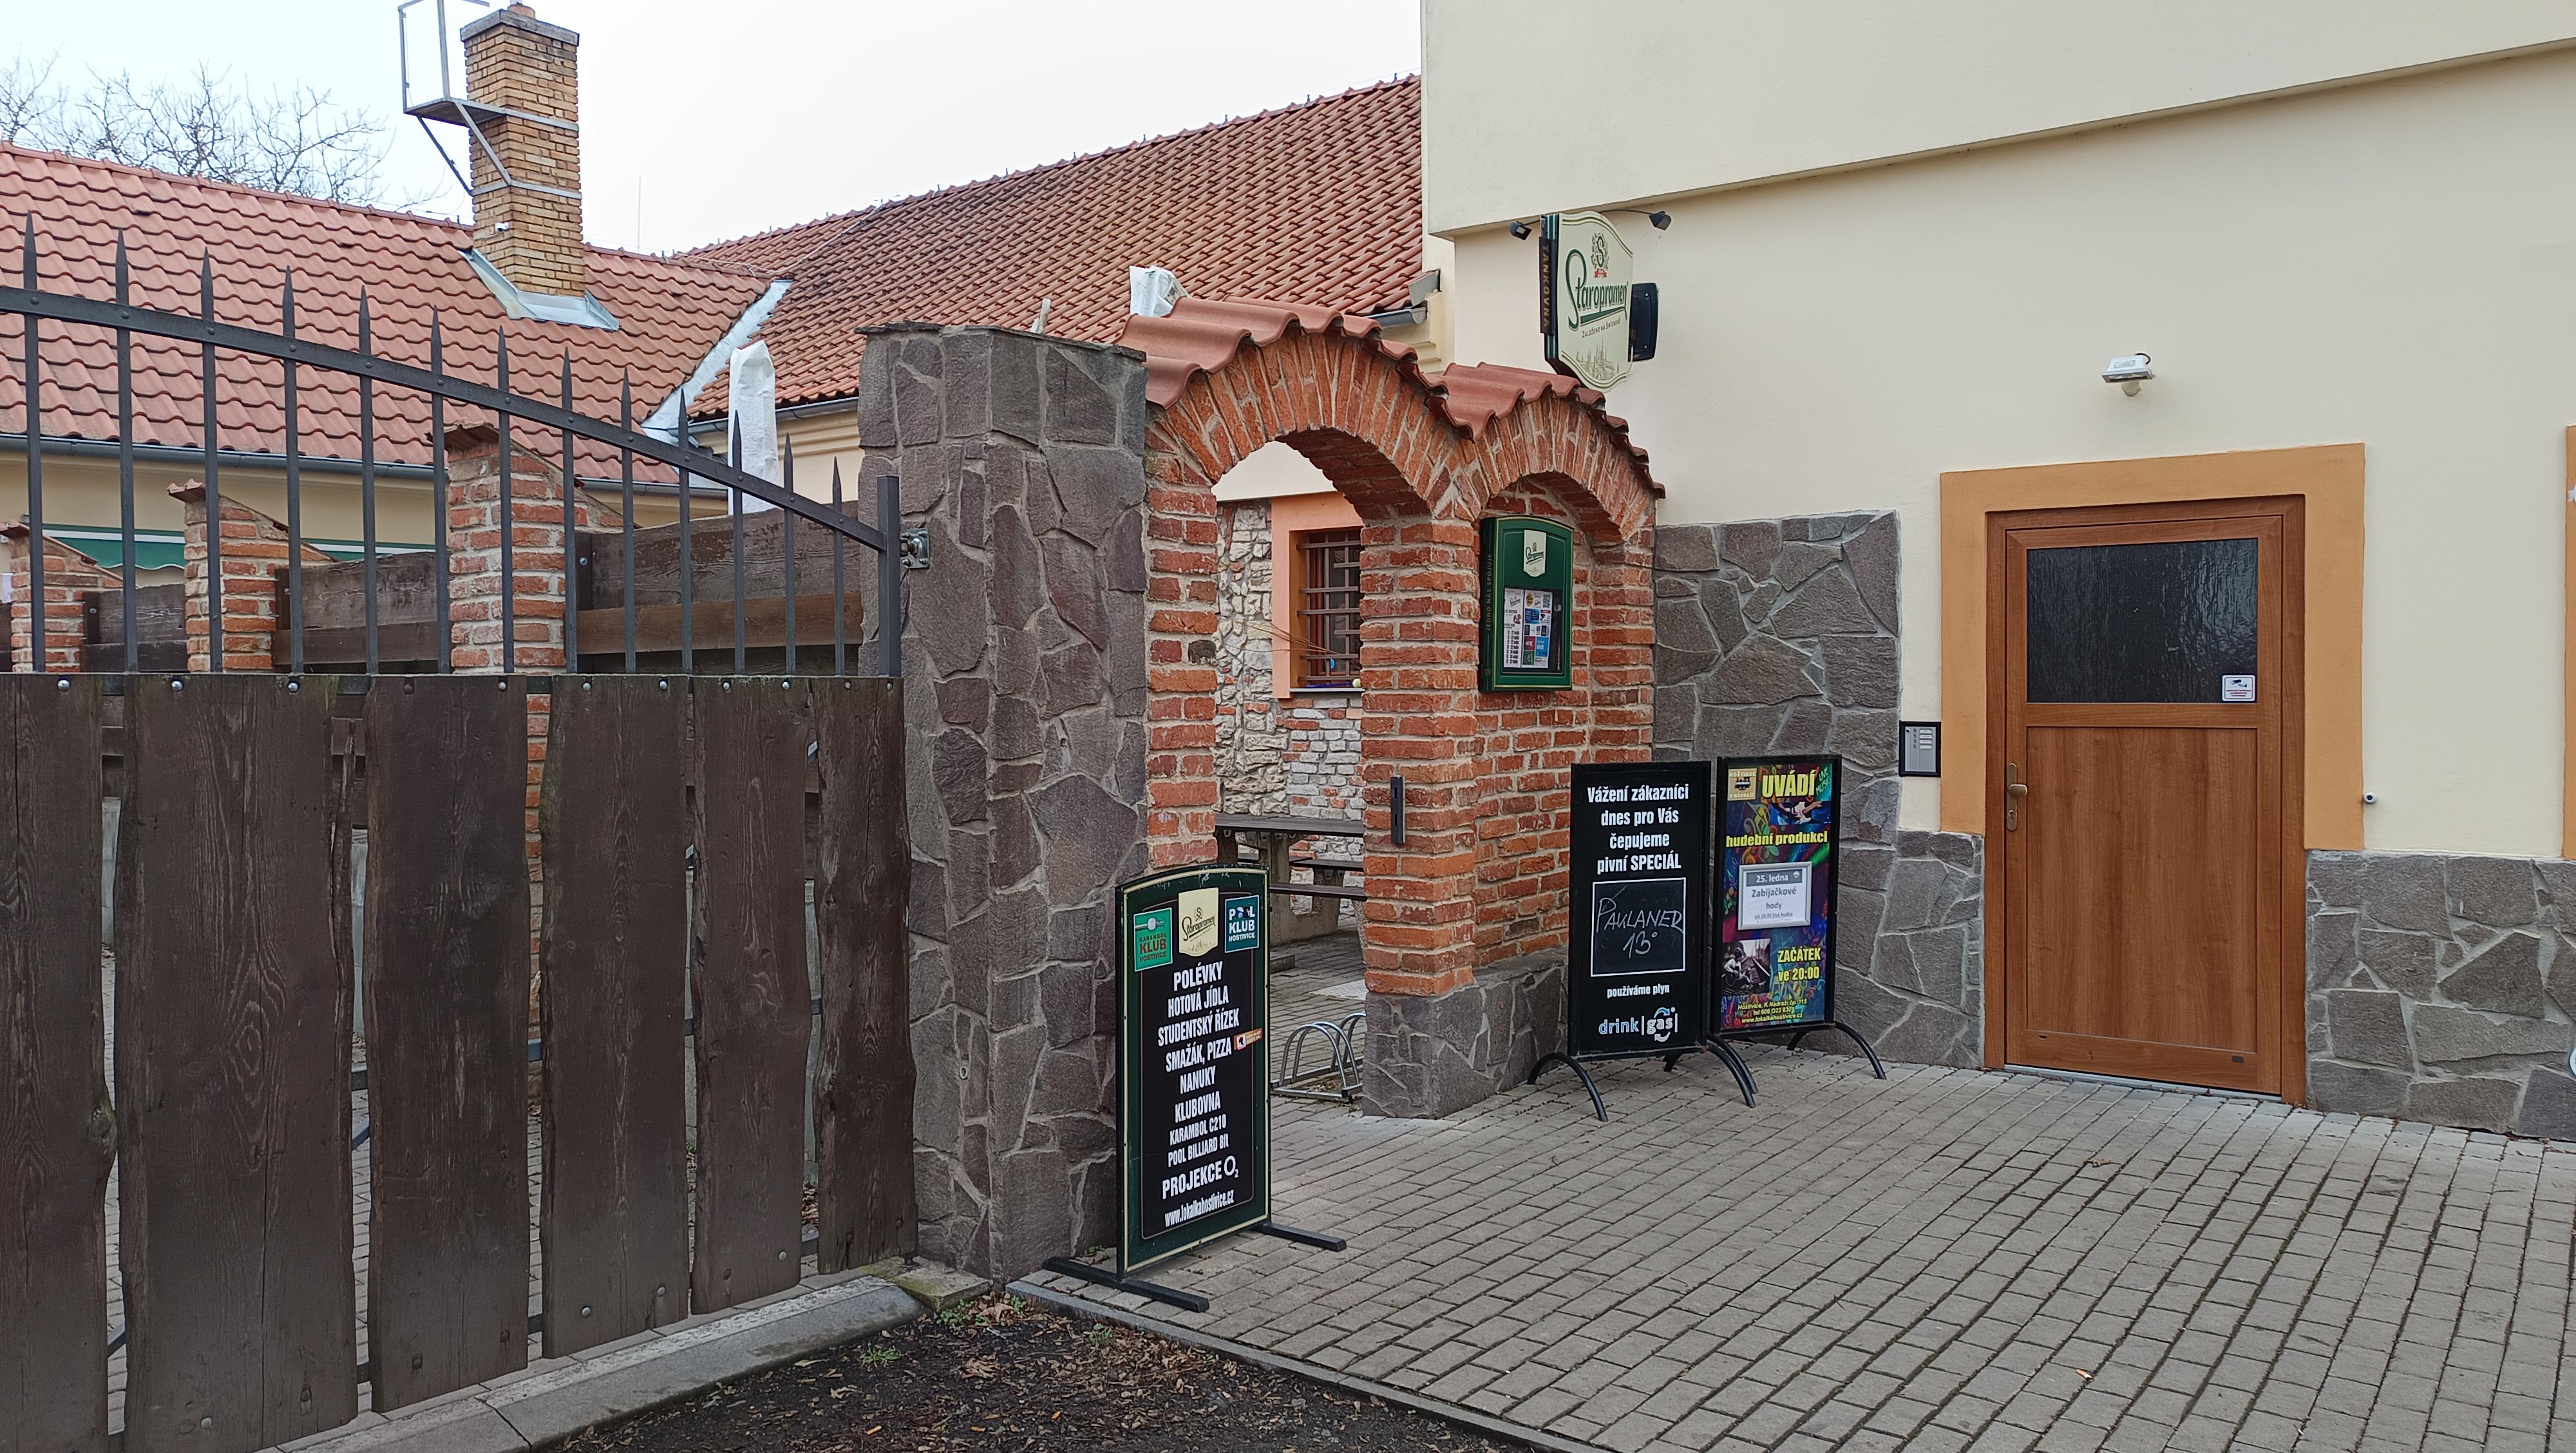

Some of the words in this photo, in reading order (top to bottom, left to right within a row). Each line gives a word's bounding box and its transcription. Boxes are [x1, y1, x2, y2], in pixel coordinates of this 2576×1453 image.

[1565, 249, 1628, 330] Staropramen
[1587, 785, 1629, 803] Vážení
[1631, 783, 1689, 802] zákazníci
[1762, 770, 1816, 798] UVÁDÍ
[1601, 810, 1631, 826] dnes
[1634, 811, 1654, 827] pro
[1657, 806, 1679, 824] Vás
[1609, 831, 1670, 851] čepujeme
[1726, 833, 1774, 848] hudební
[1775, 831, 1828, 846] produkci
[1597, 855, 1629, 875] pivní
[1630, 850, 1681, 871] SPECIÁL
[1756, 875, 1768, 883] 25.
[1768, 873, 1789, 882] ledna
[1751, 886, 1797, 898] Zabijačkové
[1766, 902, 1783, 910] hody
[1182, 915, 1217, 942] Staropramen
[1228, 931, 1256, 942] HOSTIVICE
[1229, 919, 1256, 934] KLUB
[1139, 932, 1167, 943] KARAMBOL
[1139, 938, 1167, 954] KLUB
[1139, 952, 1167, 963] HOSTIVICE
[1777, 946, 1821, 964] ZAČÁTEK
[1173, 961, 1224, 992] POLÉVKY
[1778, 970, 1790, 982] ve
[1792, 966, 1821, 981] 20:00
[1607, 985, 1651, 999] používáme
[1653, 983, 1670, 995] plyn
[1168, 987, 1202, 1018] HOTOVÁ
[1204, 985, 1229, 1009] JÍDLA
[1158, 1012, 1214, 1047] STUDENTSKÝ
[1215, 1007, 1240, 1032] ŘÍZEK
[1598, 1017, 1640, 1035] drink
[1165, 1041, 1205, 1072] SMAŽÁK,
[1207, 1036, 1233, 1061] PIZZA
[1180, 1065, 1217, 1094] NANUKY
[1175, 1090, 1221, 1123] KLUBOVNA
[1170, 1119, 1208, 1146] KARAMBOL
[1208, 1114, 1227, 1133] C210
[1168, 1148, 1187, 1168] POOL
[1187, 1136, 1218, 1161] BILLIARD
[1218, 1133, 1229, 1150] 8ft
[1162, 1160, 1222, 1200] PROJEKCE
[1164, 1189, 1235, 1228] www.lokalkahostivice.cz
